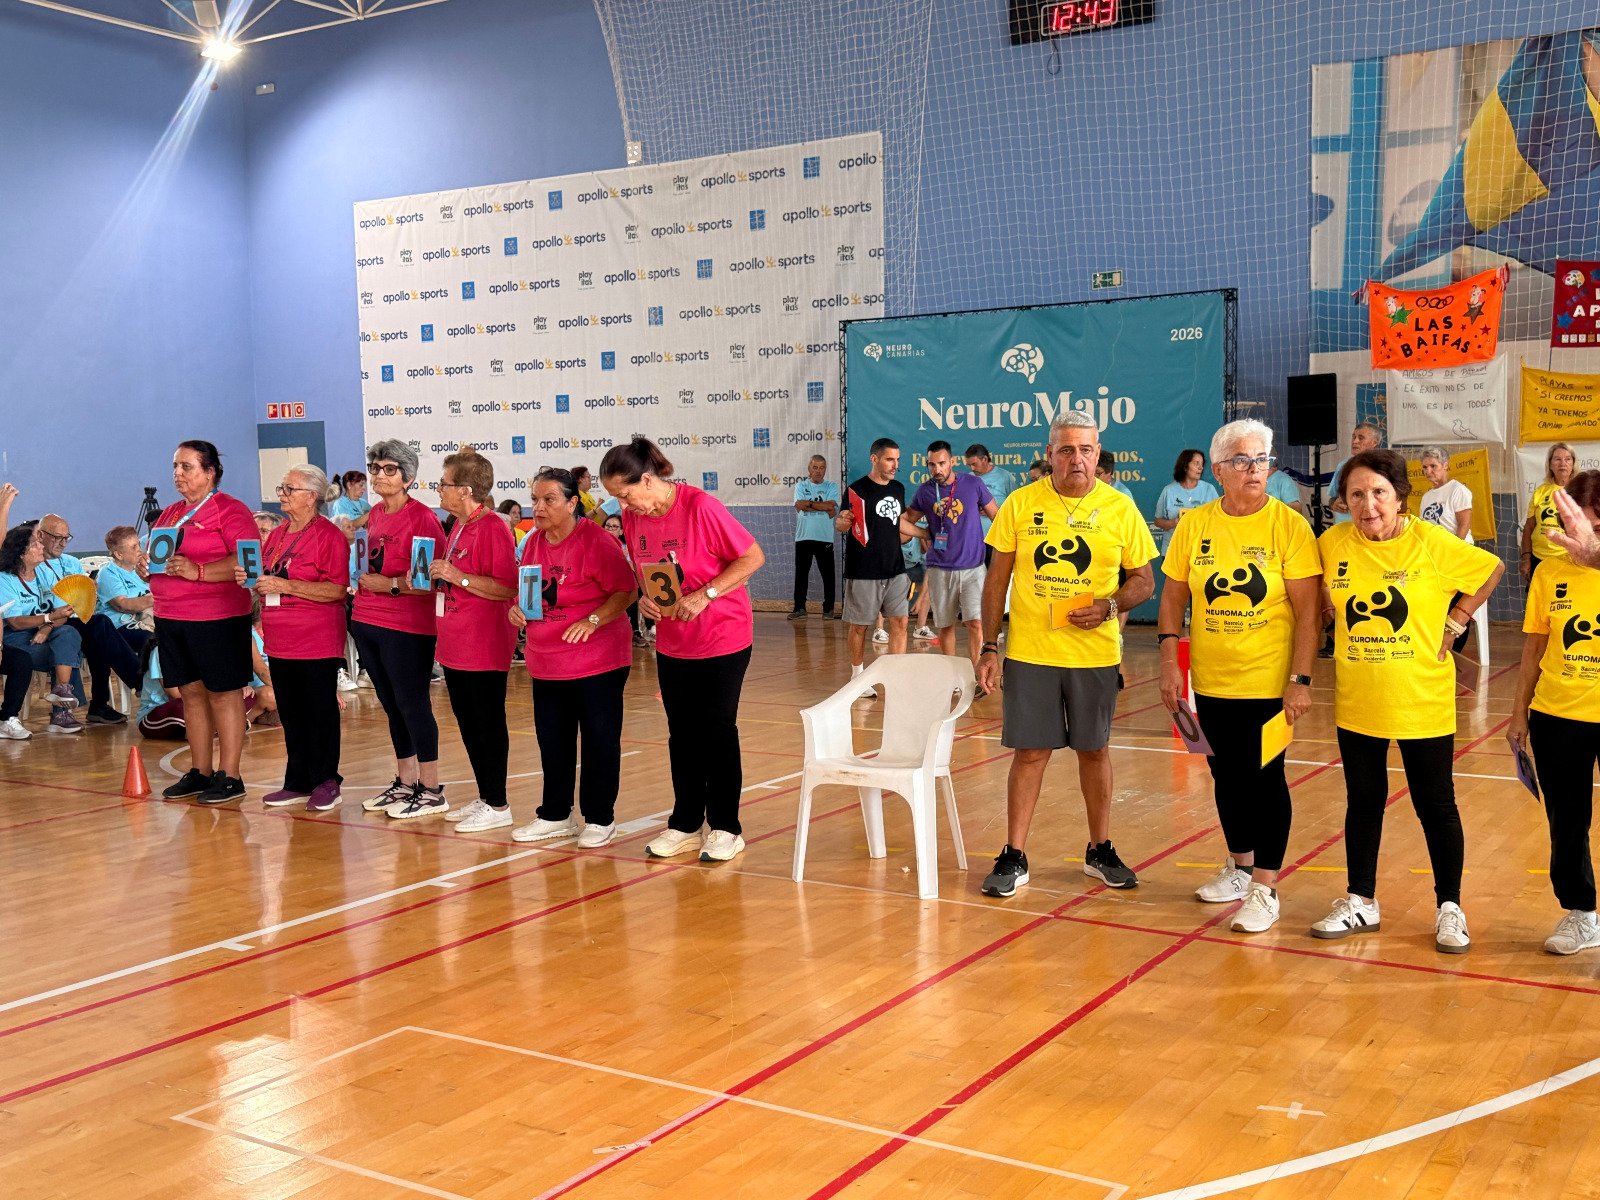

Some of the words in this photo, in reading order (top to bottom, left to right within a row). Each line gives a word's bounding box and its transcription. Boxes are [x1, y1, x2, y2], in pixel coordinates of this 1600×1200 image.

[1052, 0, 1114, 30] 12:43
[839, 153, 876, 170] apollo
[673, 176, 688, 186] play
[701, 173, 736, 189] apollo
[749, 167, 785, 183] sports
[578, 188, 608, 203] apollo
[621, 185, 653, 198] sports
[440, 205, 453, 215] play
[464, 205, 492, 218] apollo
[503, 200, 534, 213] sports
[783, 207, 819, 222] apollo
[833, 202, 871, 217] sports
[360, 216, 386, 231] apollo
[396, 212, 423, 226] sports
[651, 224, 685, 237] apollo
[698, 219, 732, 233] sports
[625, 224, 638, 236] play
[532, 235, 563, 250] apollo
[574, 232, 606, 247] sports
[400, 249, 412, 259] play
[423, 247, 450, 262] apollo
[461, 245, 490, 258] sports
[837, 245, 854, 256] play
[358, 256, 384, 268] sports
[729, 259, 764, 272] apollo
[778, 254, 815, 269] sports
[579, 271, 592, 281] play
[605, 270, 636, 285] apollo
[648, 268, 680, 282] sports
[489, 280, 518, 294] apollo
[529, 279, 560, 291] sports
[361, 292, 373, 301] play
[383, 291, 410, 303] apollo
[420, 289, 448, 302] sports
[783, 296, 798, 306] play
[812, 295, 849, 310] apollo
[679, 307, 712, 321] apollo
[725, 303, 761, 318] sports
[534, 315, 547, 326] play
[559, 315, 589, 329] apollo
[601, 314, 632, 326] sports
[1415, 316, 1453, 331] LAS
[380, 330, 408, 343] sports
[447, 324, 475, 337] apollo
[486, 323, 516, 335] sports
[1170, 327, 1203, 341] 2026
[730, 343, 745, 353] play
[759, 343, 793, 358] apollo
[1401, 334, 1470, 358] BAIFAS
[631, 351, 663, 366] apollo
[675, 350, 709, 363] sports
[886, 350, 925, 358] CANARIAS
[407, 366, 434, 379] apollo
[445, 364, 473, 377] sports
[491, 359, 503, 369] play
[515, 360, 544, 374] apollo
[555, 358, 586, 370] sports
[679, 389, 694, 399] play
[707, 389, 741, 403] apollo
[754, 388, 789, 401] sports
[448, 401, 461, 410] play
[472, 401, 500, 414] apollo
[512, 400, 541, 412] sports
[585, 396, 615, 409] apollo
[627, 395, 659, 408] sports
[368, 406, 394, 419] apollo
[404, 404, 432, 417] sports
[1552, 408, 1588, 417] TENEMOS
[540, 438, 569, 451] apollo
[581, 438, 612, 450] sports
[658, 434, 690, 448] apollo
[702, 433, 736, 446] sports
[788, 430, 822, 444] apollo
[431, 442, 459, 454] apollo
[497, 478, 525, 493] apollo
[735, 474, 770, 488] apollo
[150, 534, 174, 564] O
[357, 538, 366, 570] P
[243, 548, 258, 578] E
[412, 547, 430, 580] A
[1035, 574, 1079, 584] NEUROMAJO
[524, 575, 538, 610] T
[650, 572, 676, 607] 3
[1206, 609, 1254, 617] NEUROMAJO
